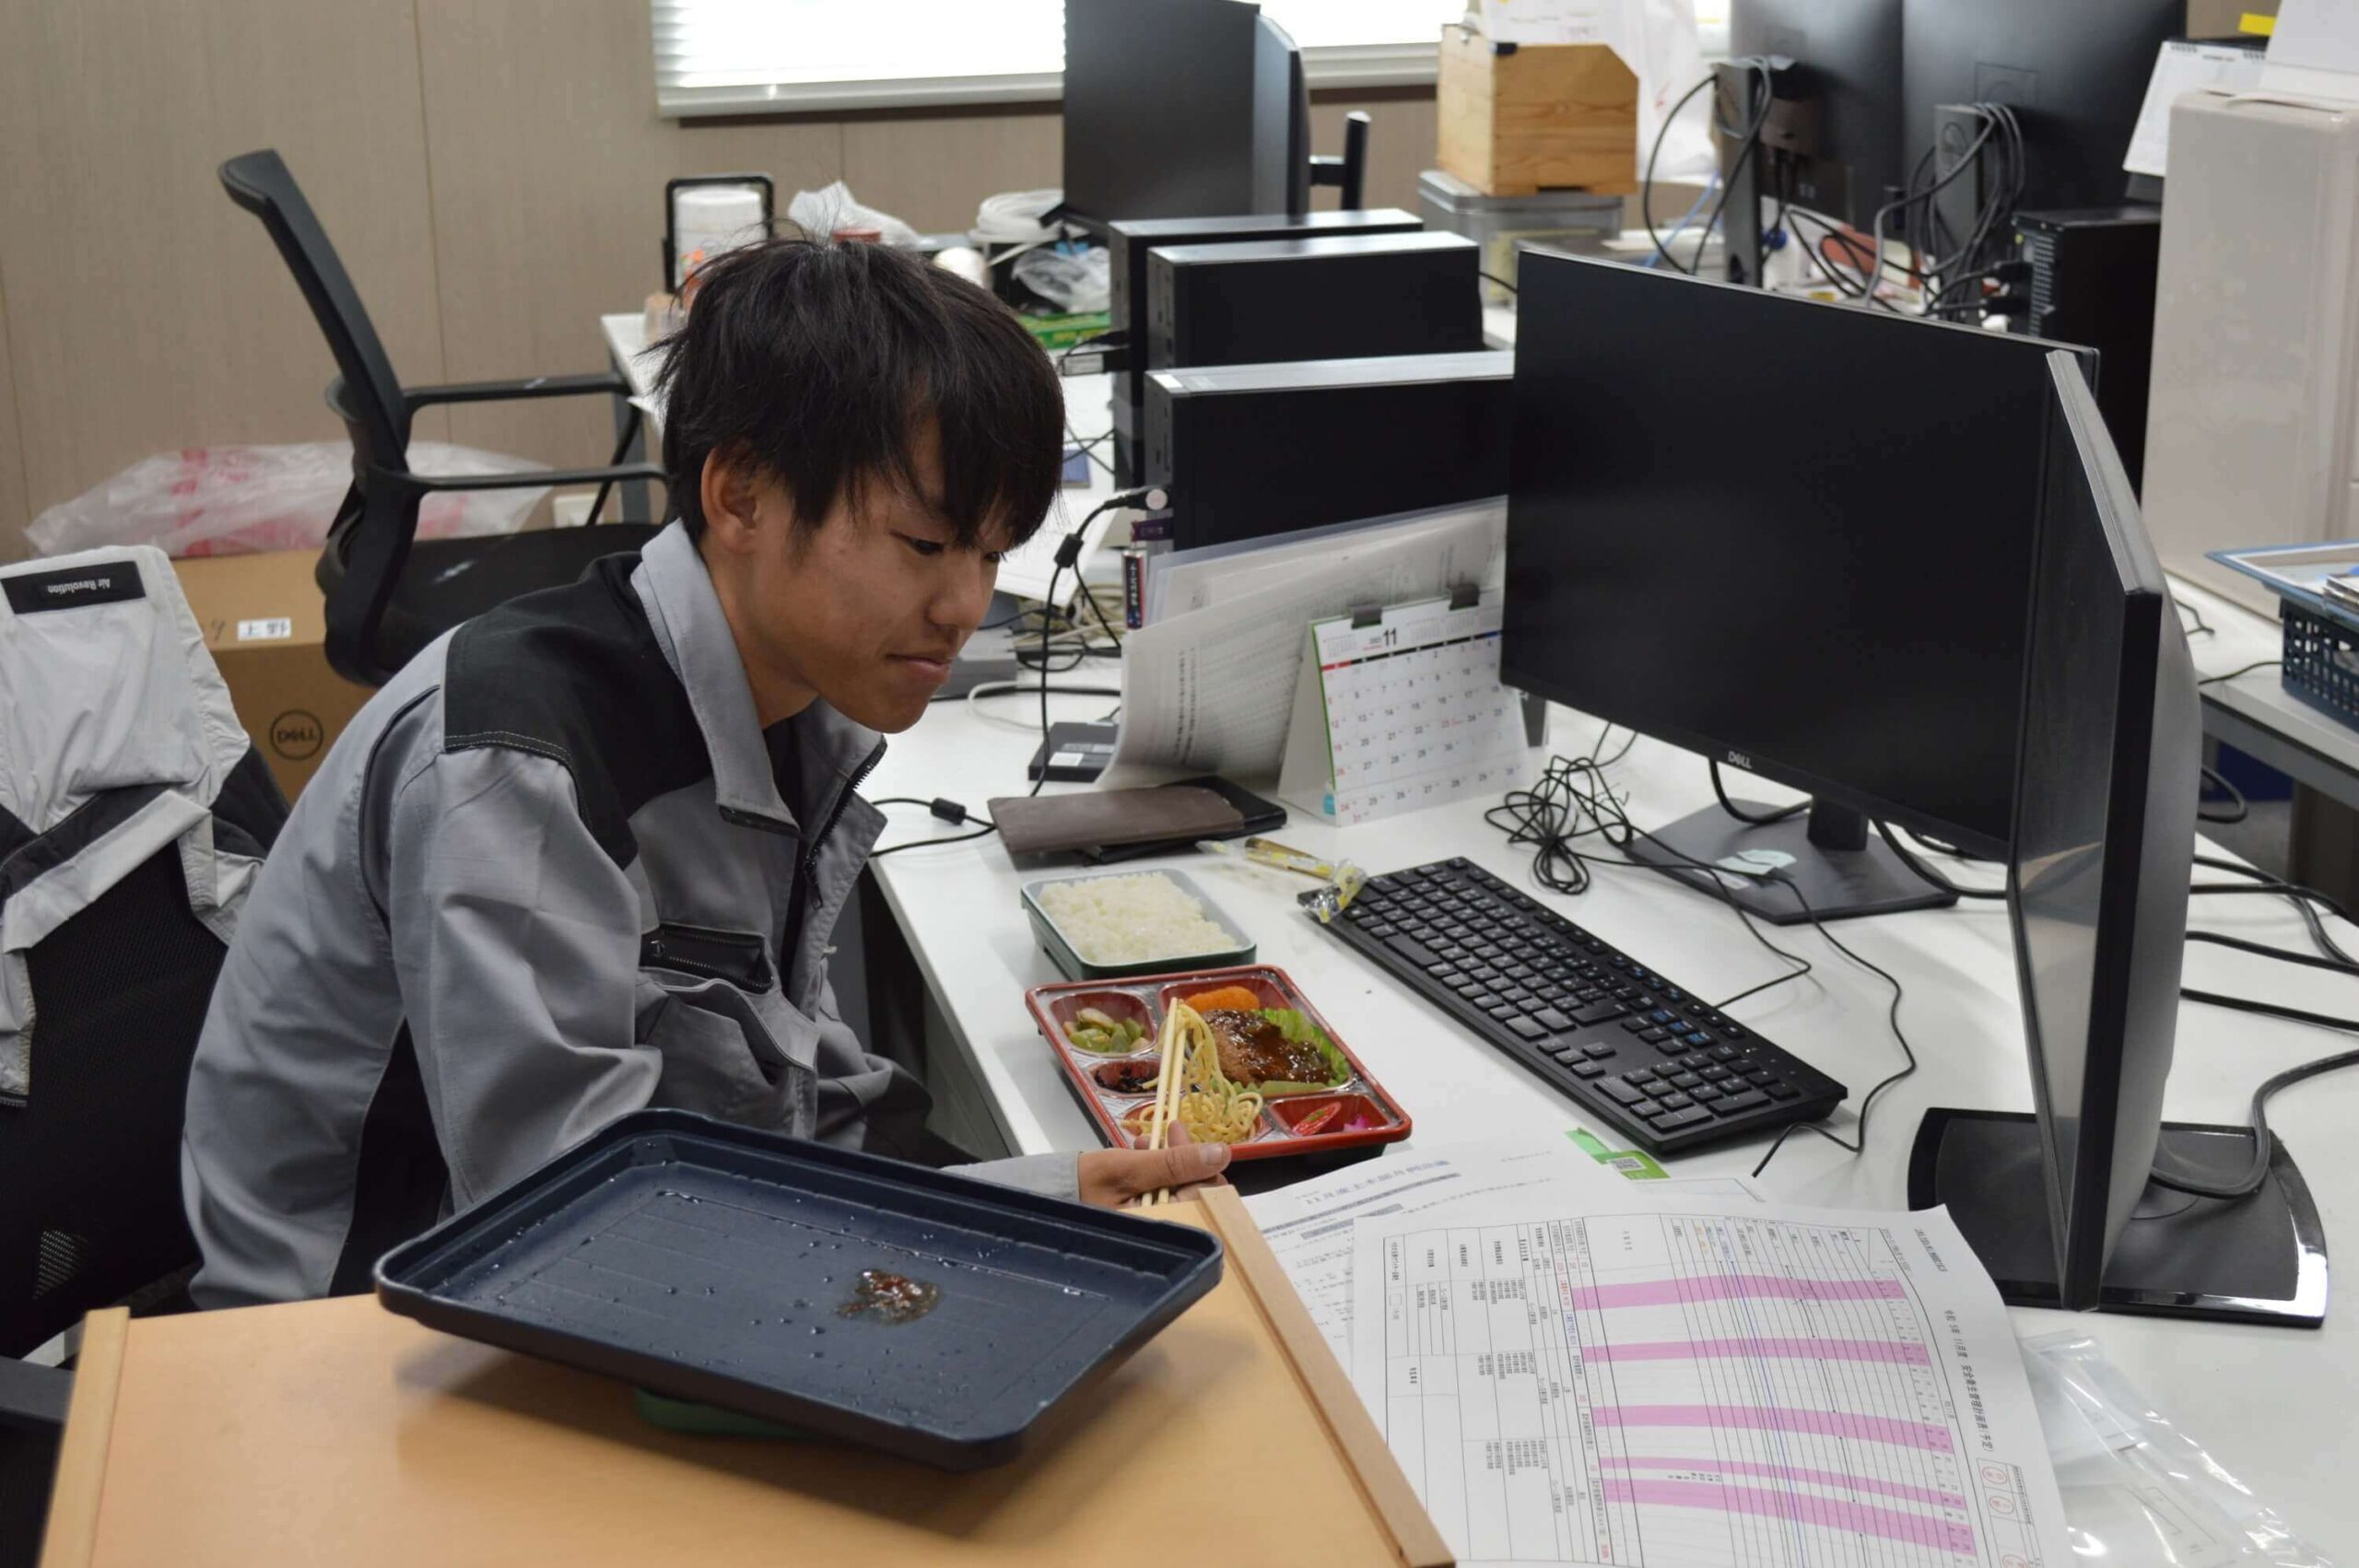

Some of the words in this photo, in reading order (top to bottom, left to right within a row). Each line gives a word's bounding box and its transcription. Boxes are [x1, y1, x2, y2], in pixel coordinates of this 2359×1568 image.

[47, 579, 97, 594] Revolution
[98, 578, 111, 590] Air
[1383, 627, 1398, 647] 11
[276, 726, 316, 745] DELL
[1727, 750, 1753, 770] DELL
